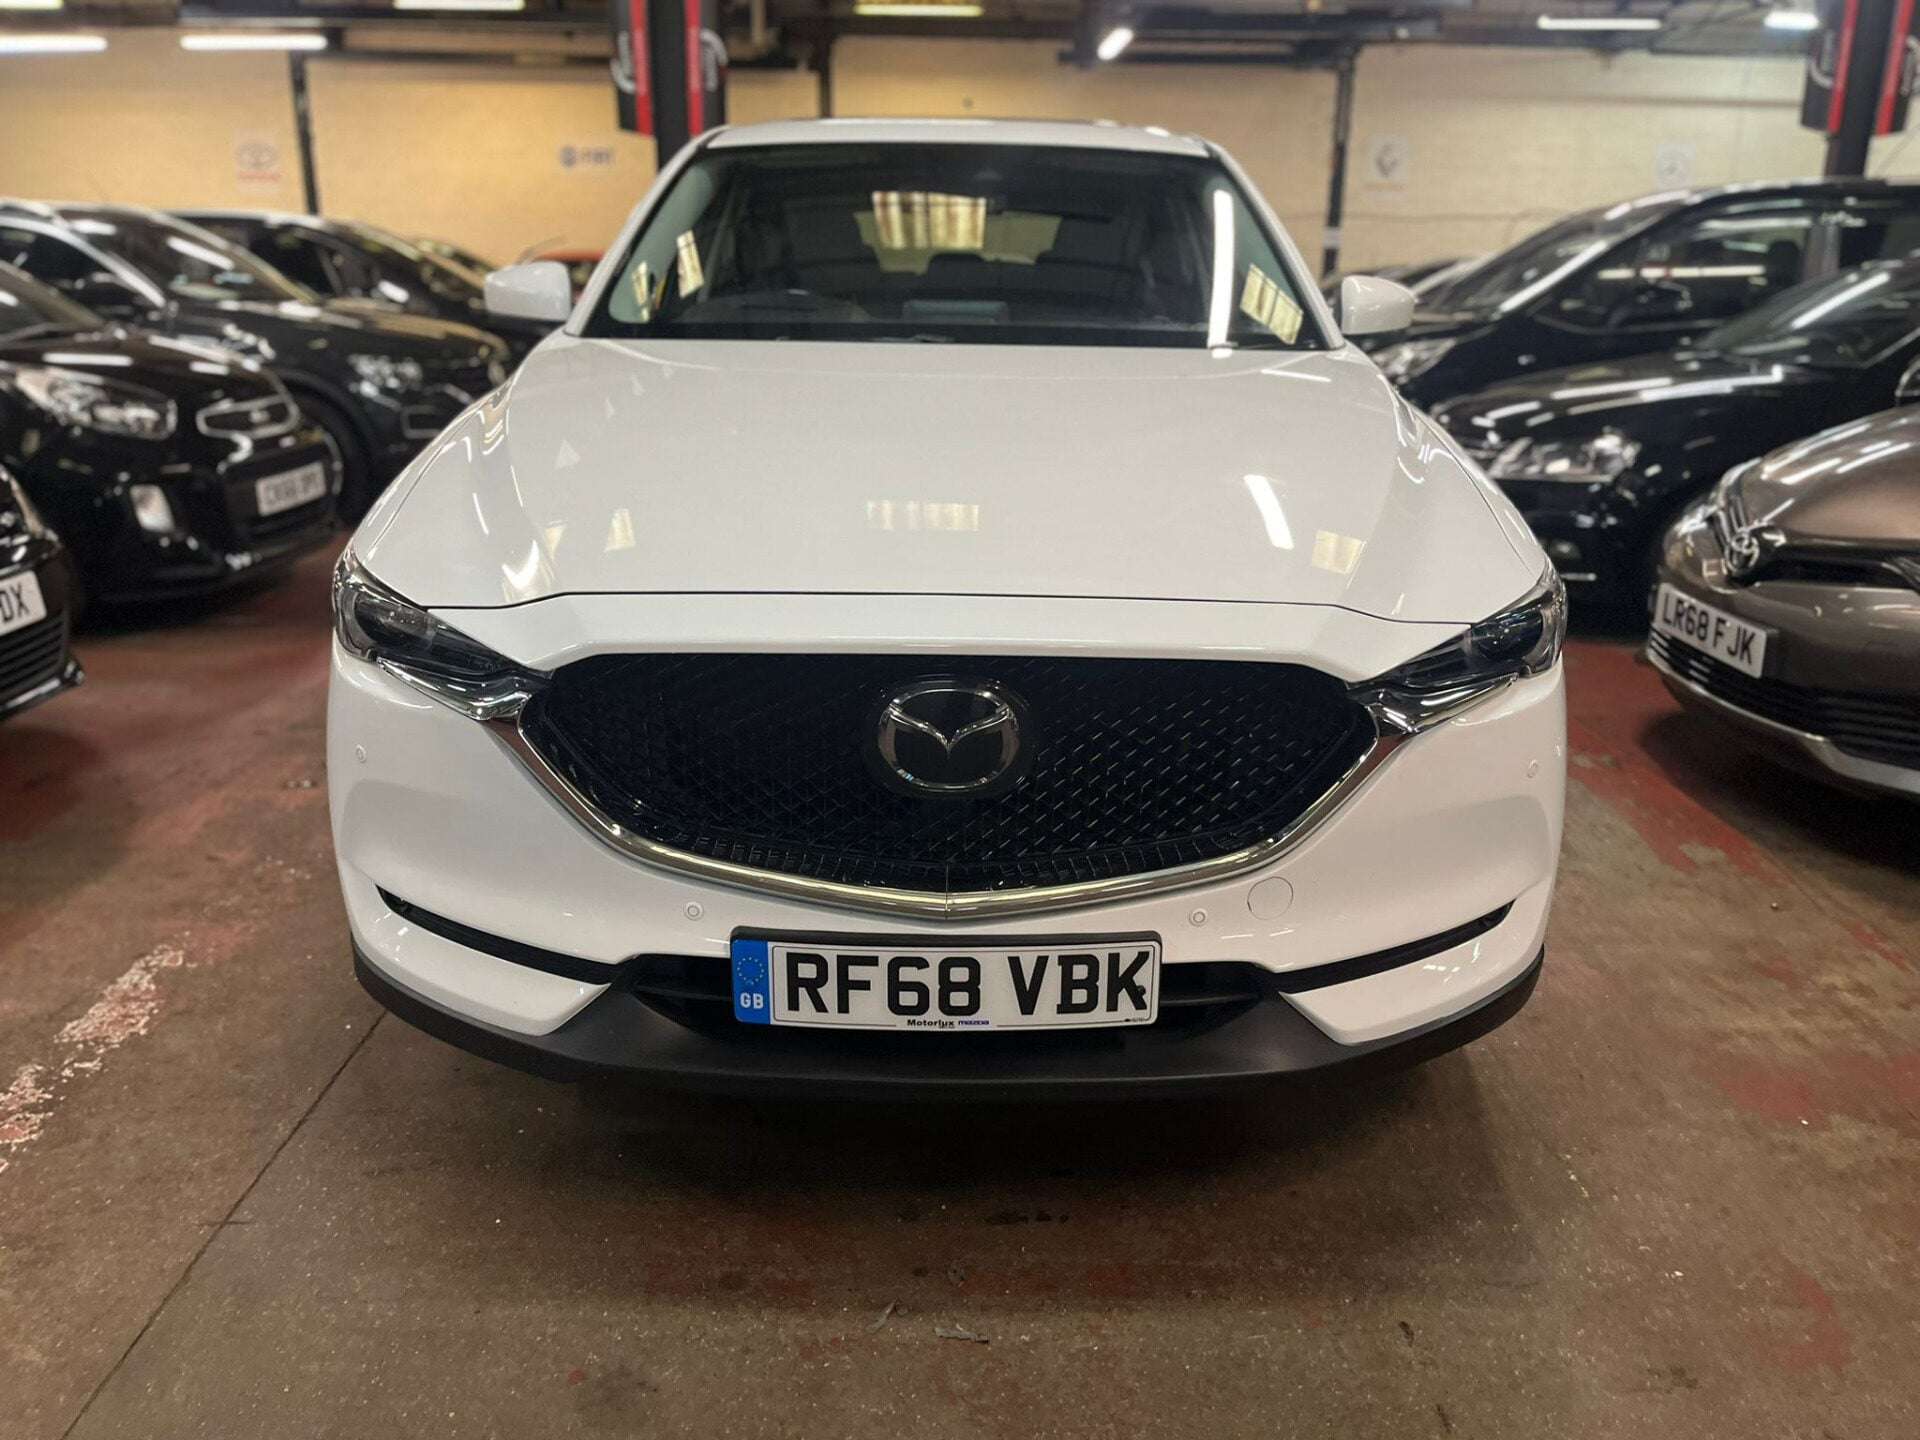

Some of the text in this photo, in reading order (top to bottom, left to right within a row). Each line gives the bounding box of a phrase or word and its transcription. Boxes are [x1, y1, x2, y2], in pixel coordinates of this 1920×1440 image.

[1663, 593, 1756, 666] LR68 FJK
[740, 992, 764, 1009] GB
[785, 951, 1151, 1016] RF68 VBK
[907, 1019, 954, 1028] Motorlux
